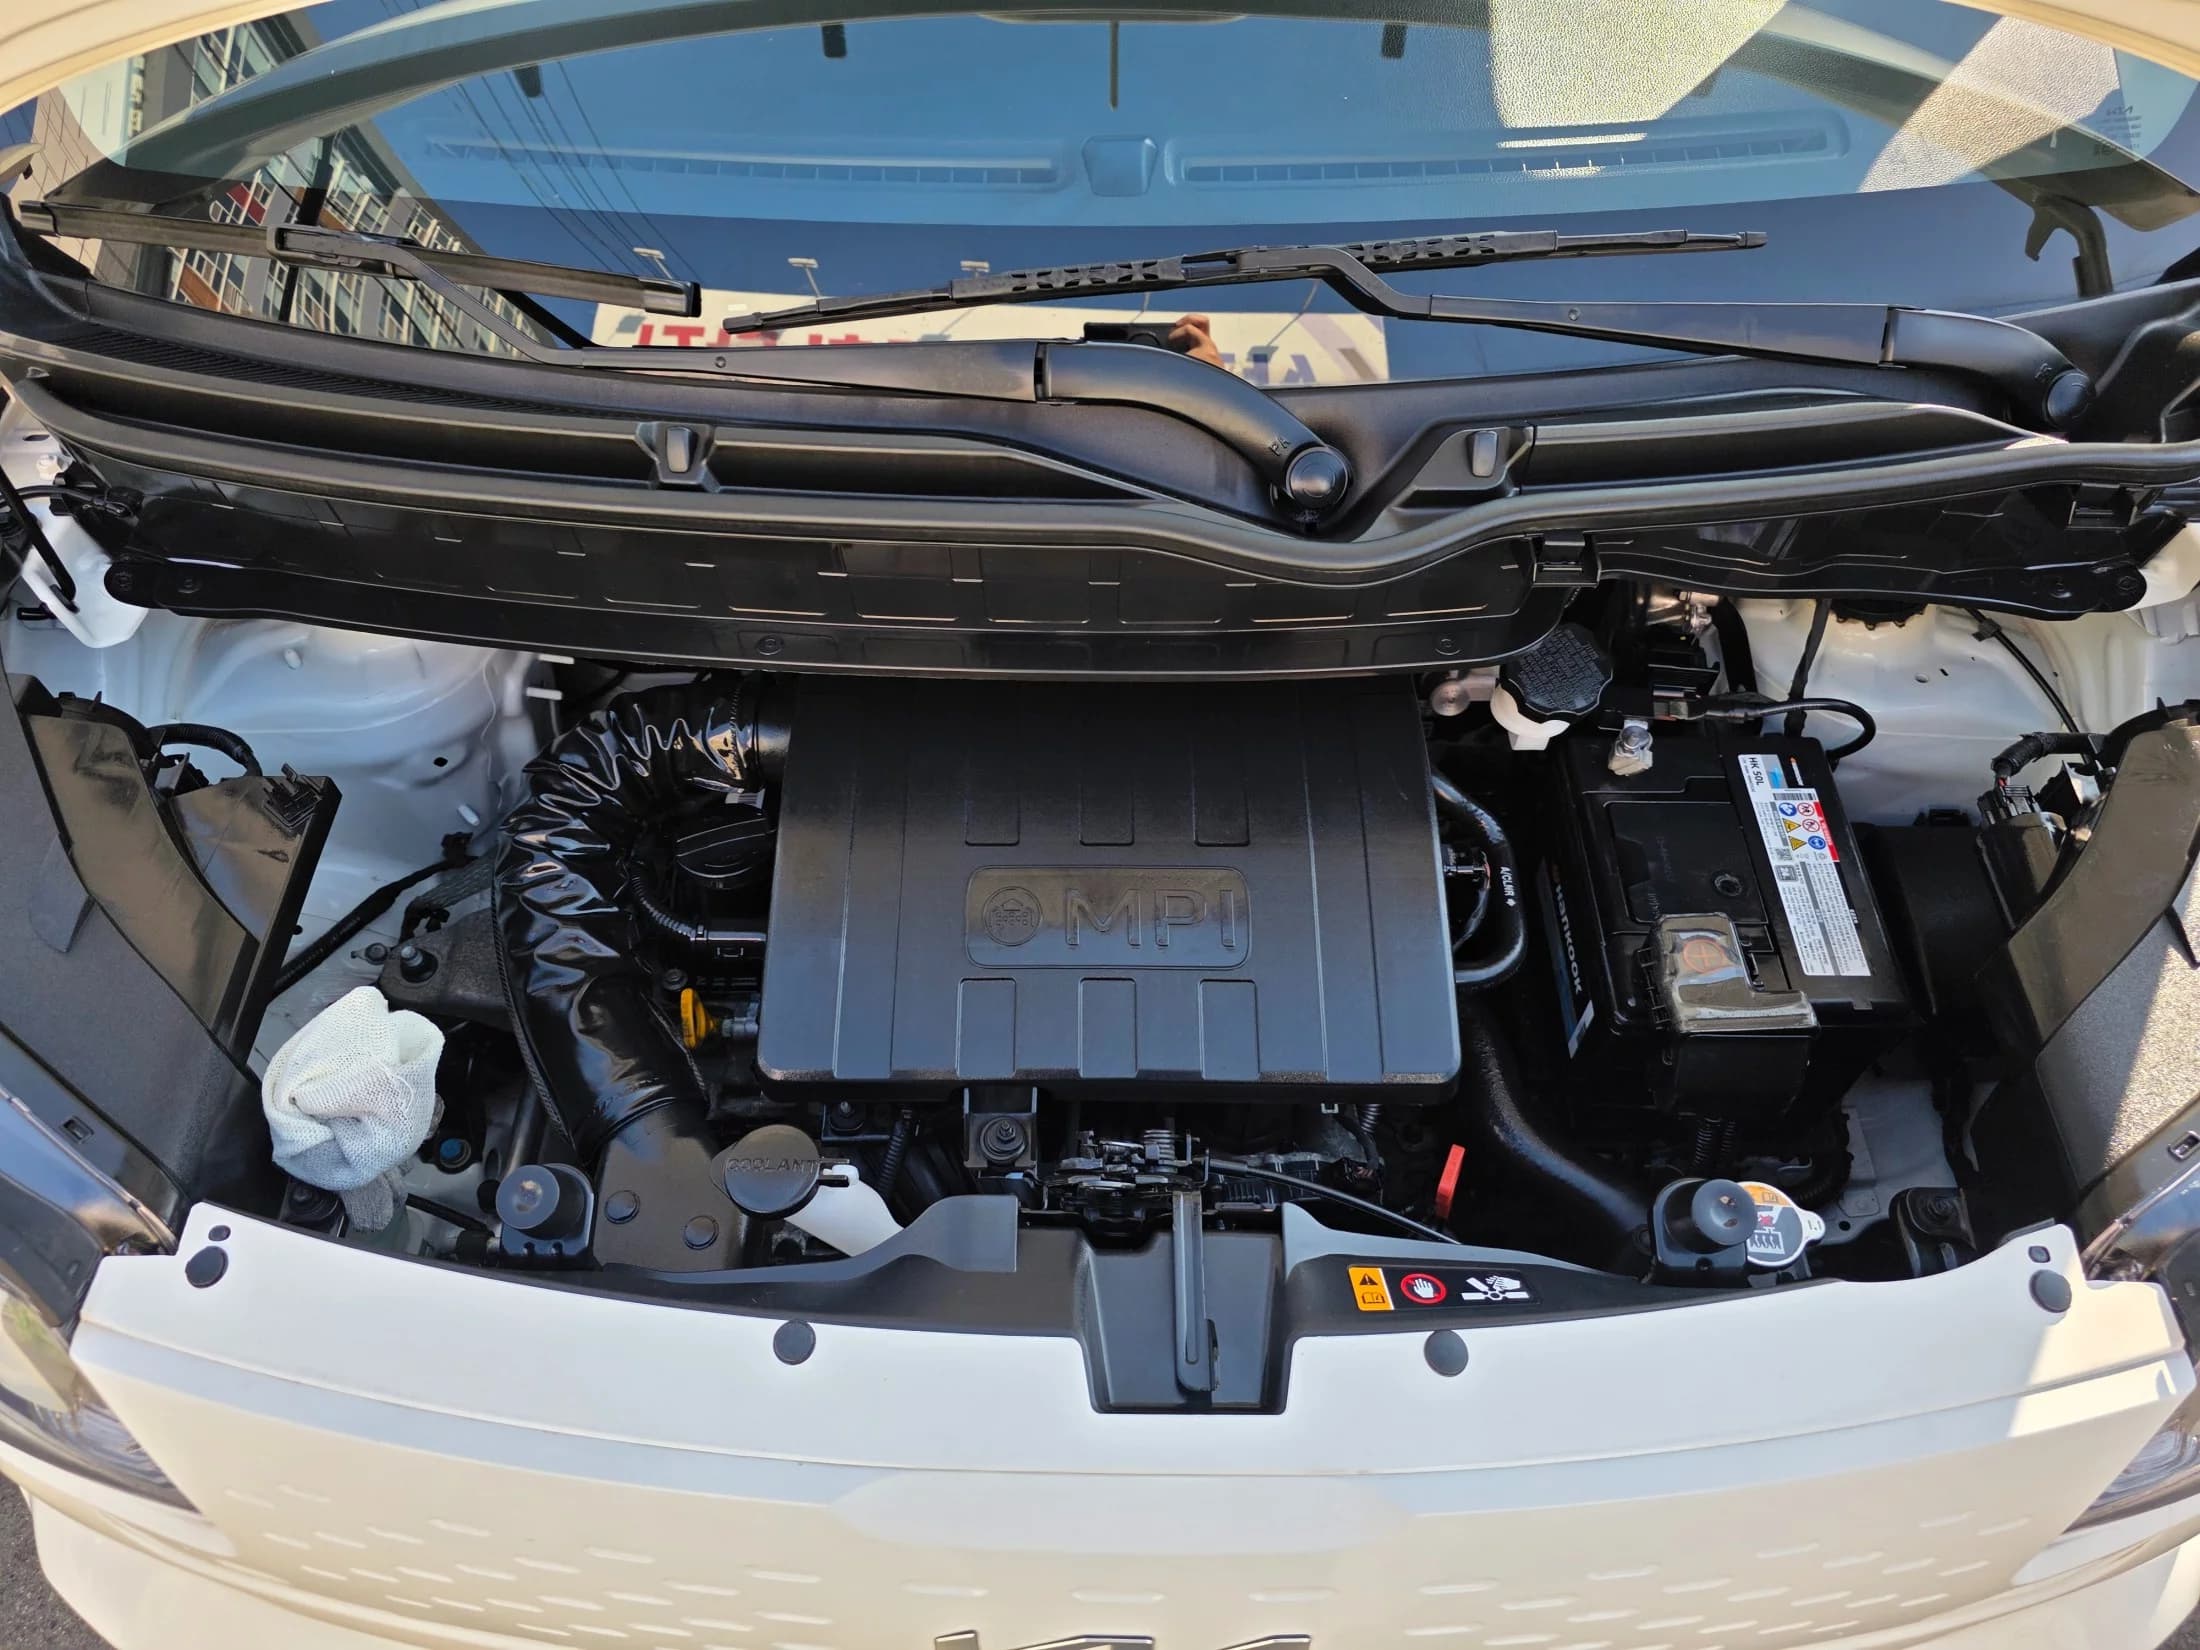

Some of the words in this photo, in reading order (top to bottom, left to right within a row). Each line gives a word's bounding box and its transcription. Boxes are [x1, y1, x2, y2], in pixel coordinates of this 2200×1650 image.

[1748, 757, 1759, 769] HK
[1753, 769, 1763, 786] 50L
[1065, 889, 1236, 947] MPI
[728, 1158, 818, 1174] COOLANT
